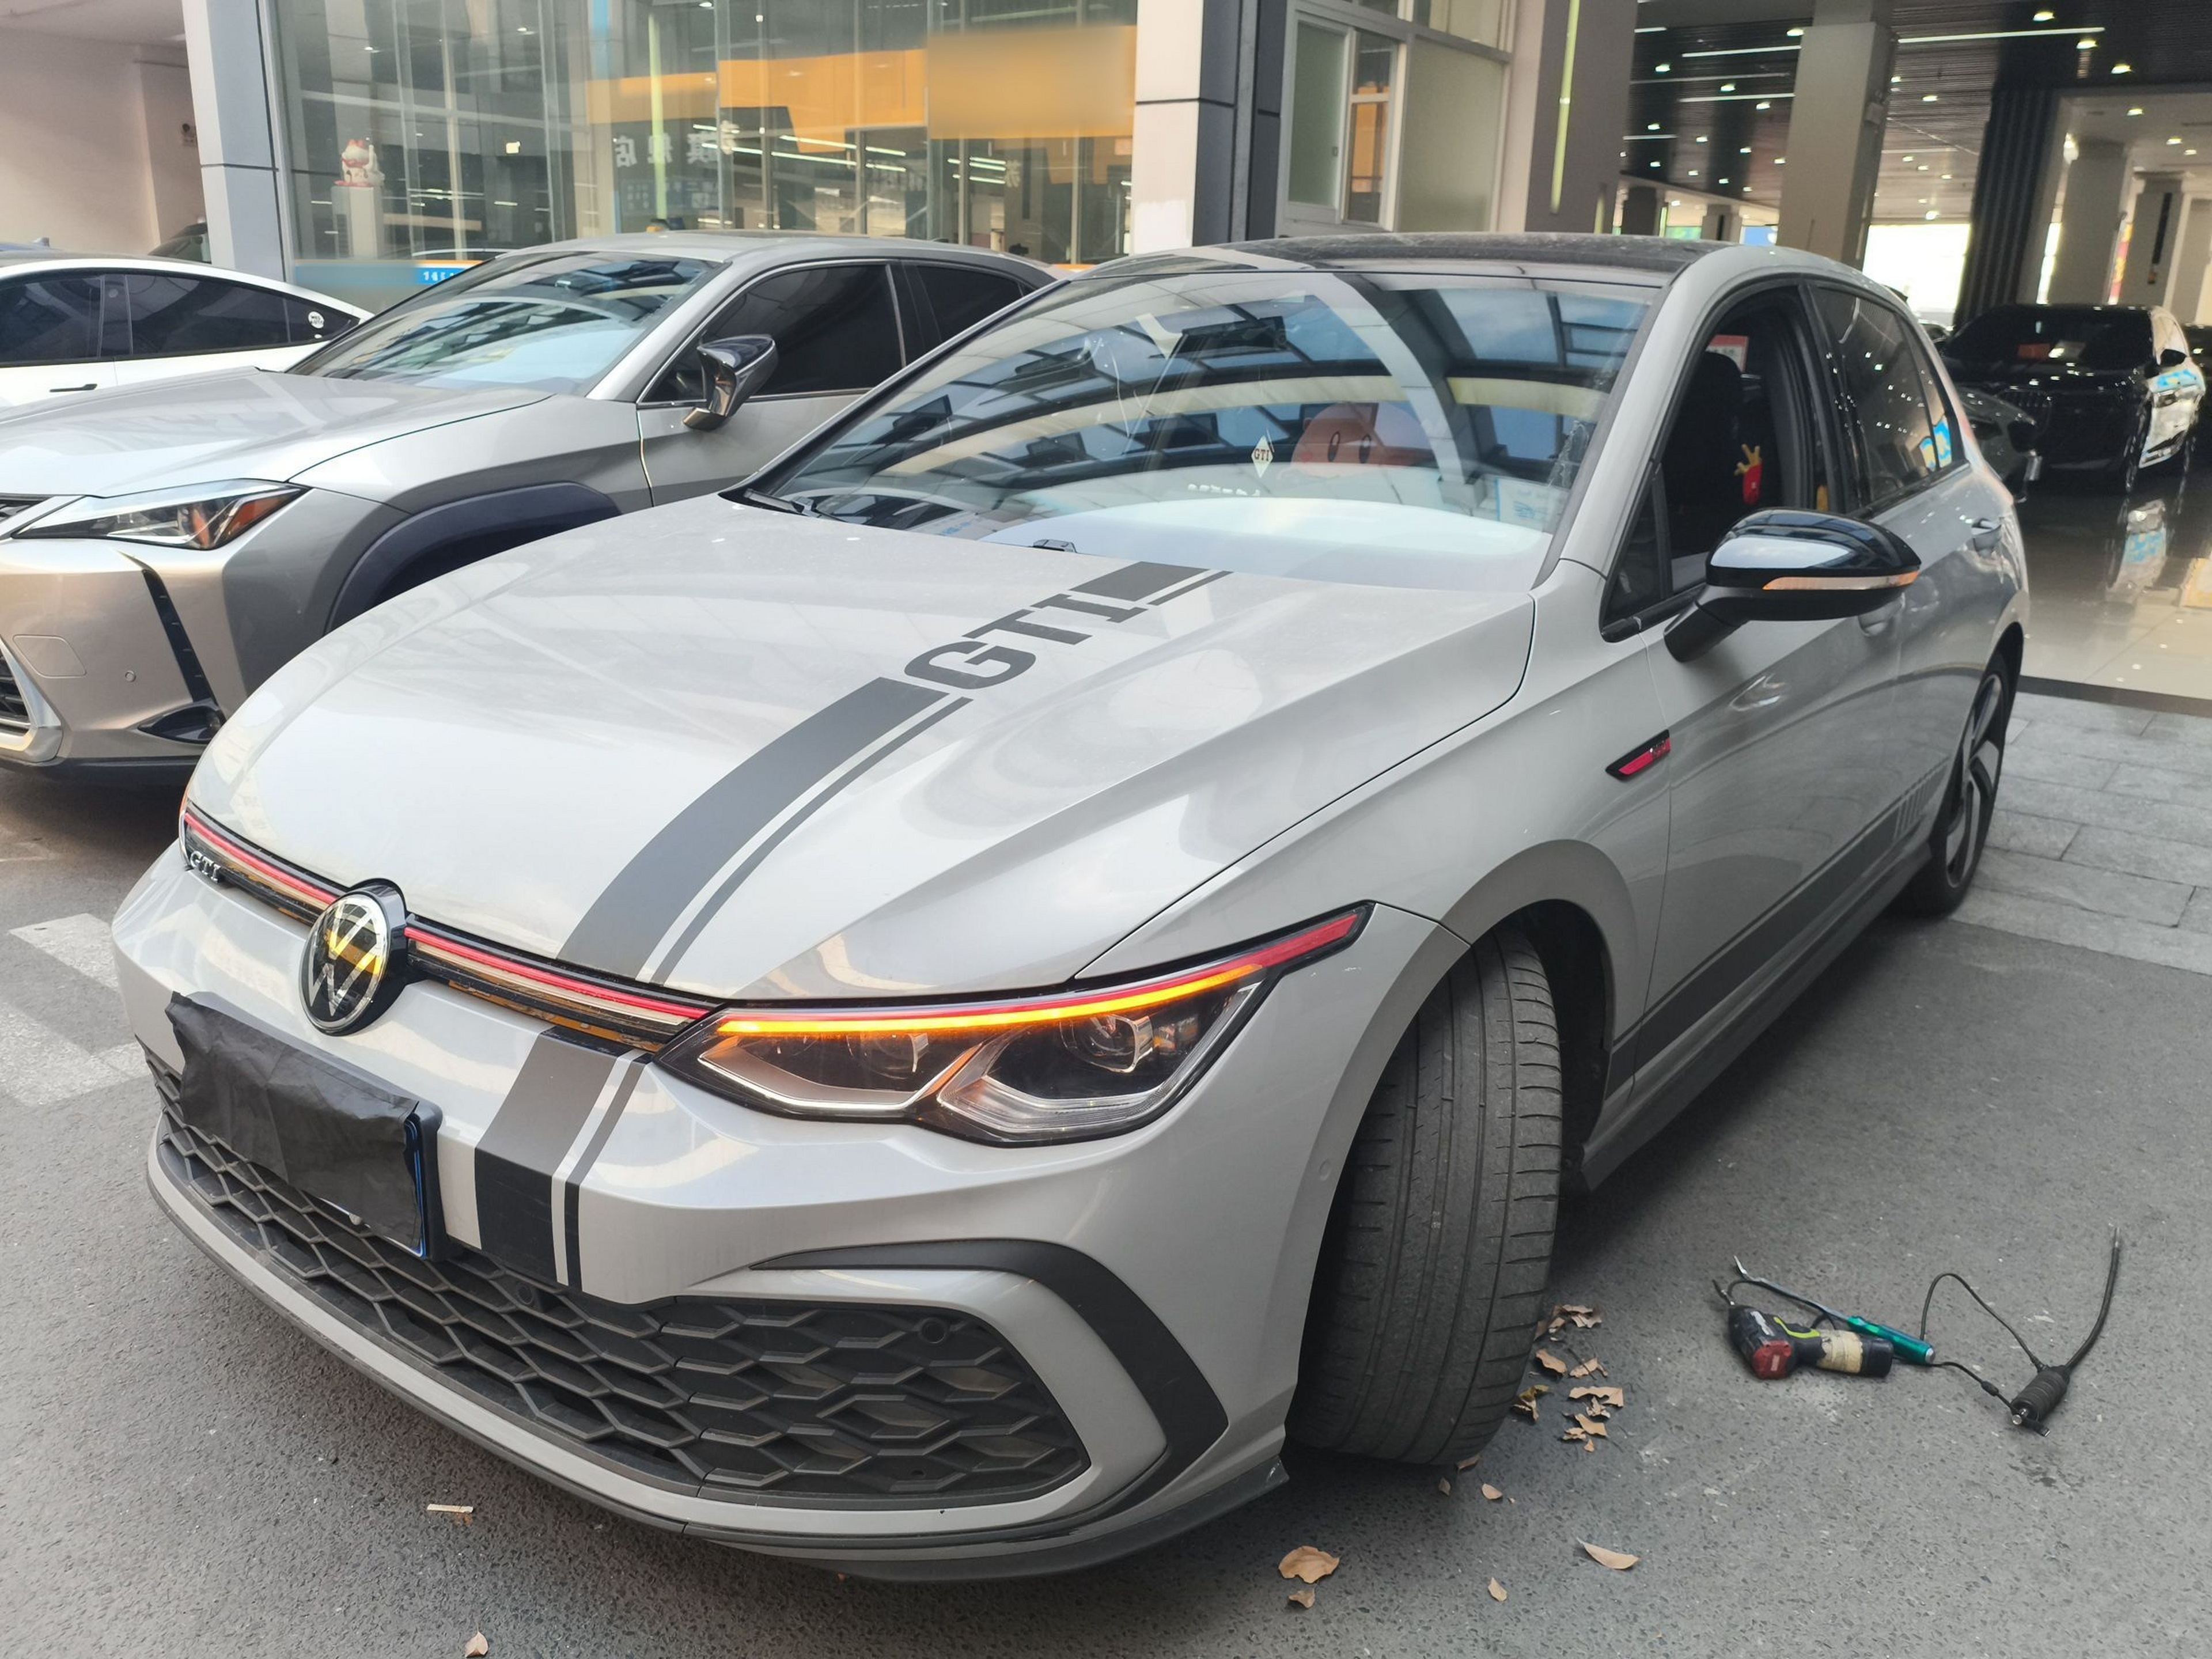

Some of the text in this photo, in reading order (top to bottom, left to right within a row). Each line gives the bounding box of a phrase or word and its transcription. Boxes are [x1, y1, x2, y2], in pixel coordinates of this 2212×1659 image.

[1254, 448, 1270, 461] GTI
[904, 593, 1148, 690] GTI
[190, 851, 221, 881] GTI
